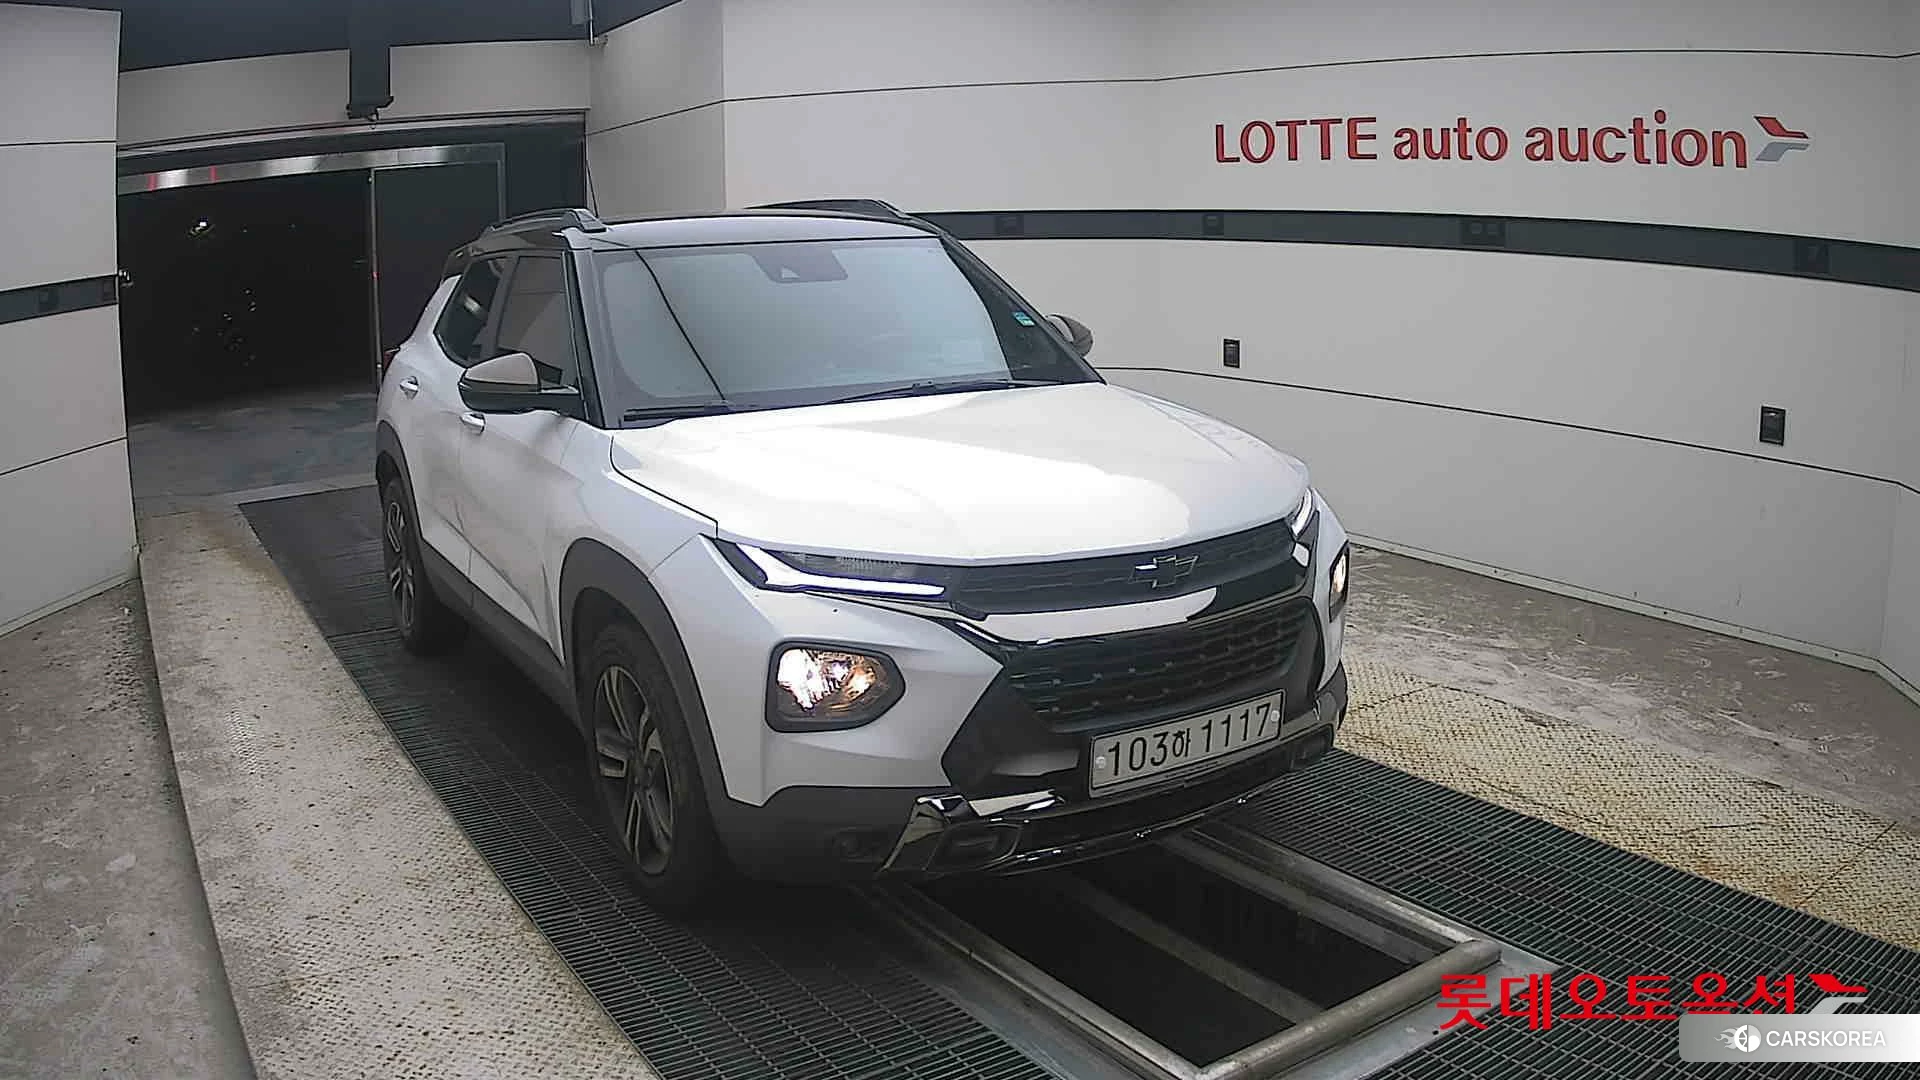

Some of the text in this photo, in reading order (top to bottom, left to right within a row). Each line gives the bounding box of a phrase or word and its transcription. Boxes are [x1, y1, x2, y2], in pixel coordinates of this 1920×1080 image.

[1214, 110, 1748, 168] LOTTE auto auction
[1108, 702, 1271, 777] 103하 1117
